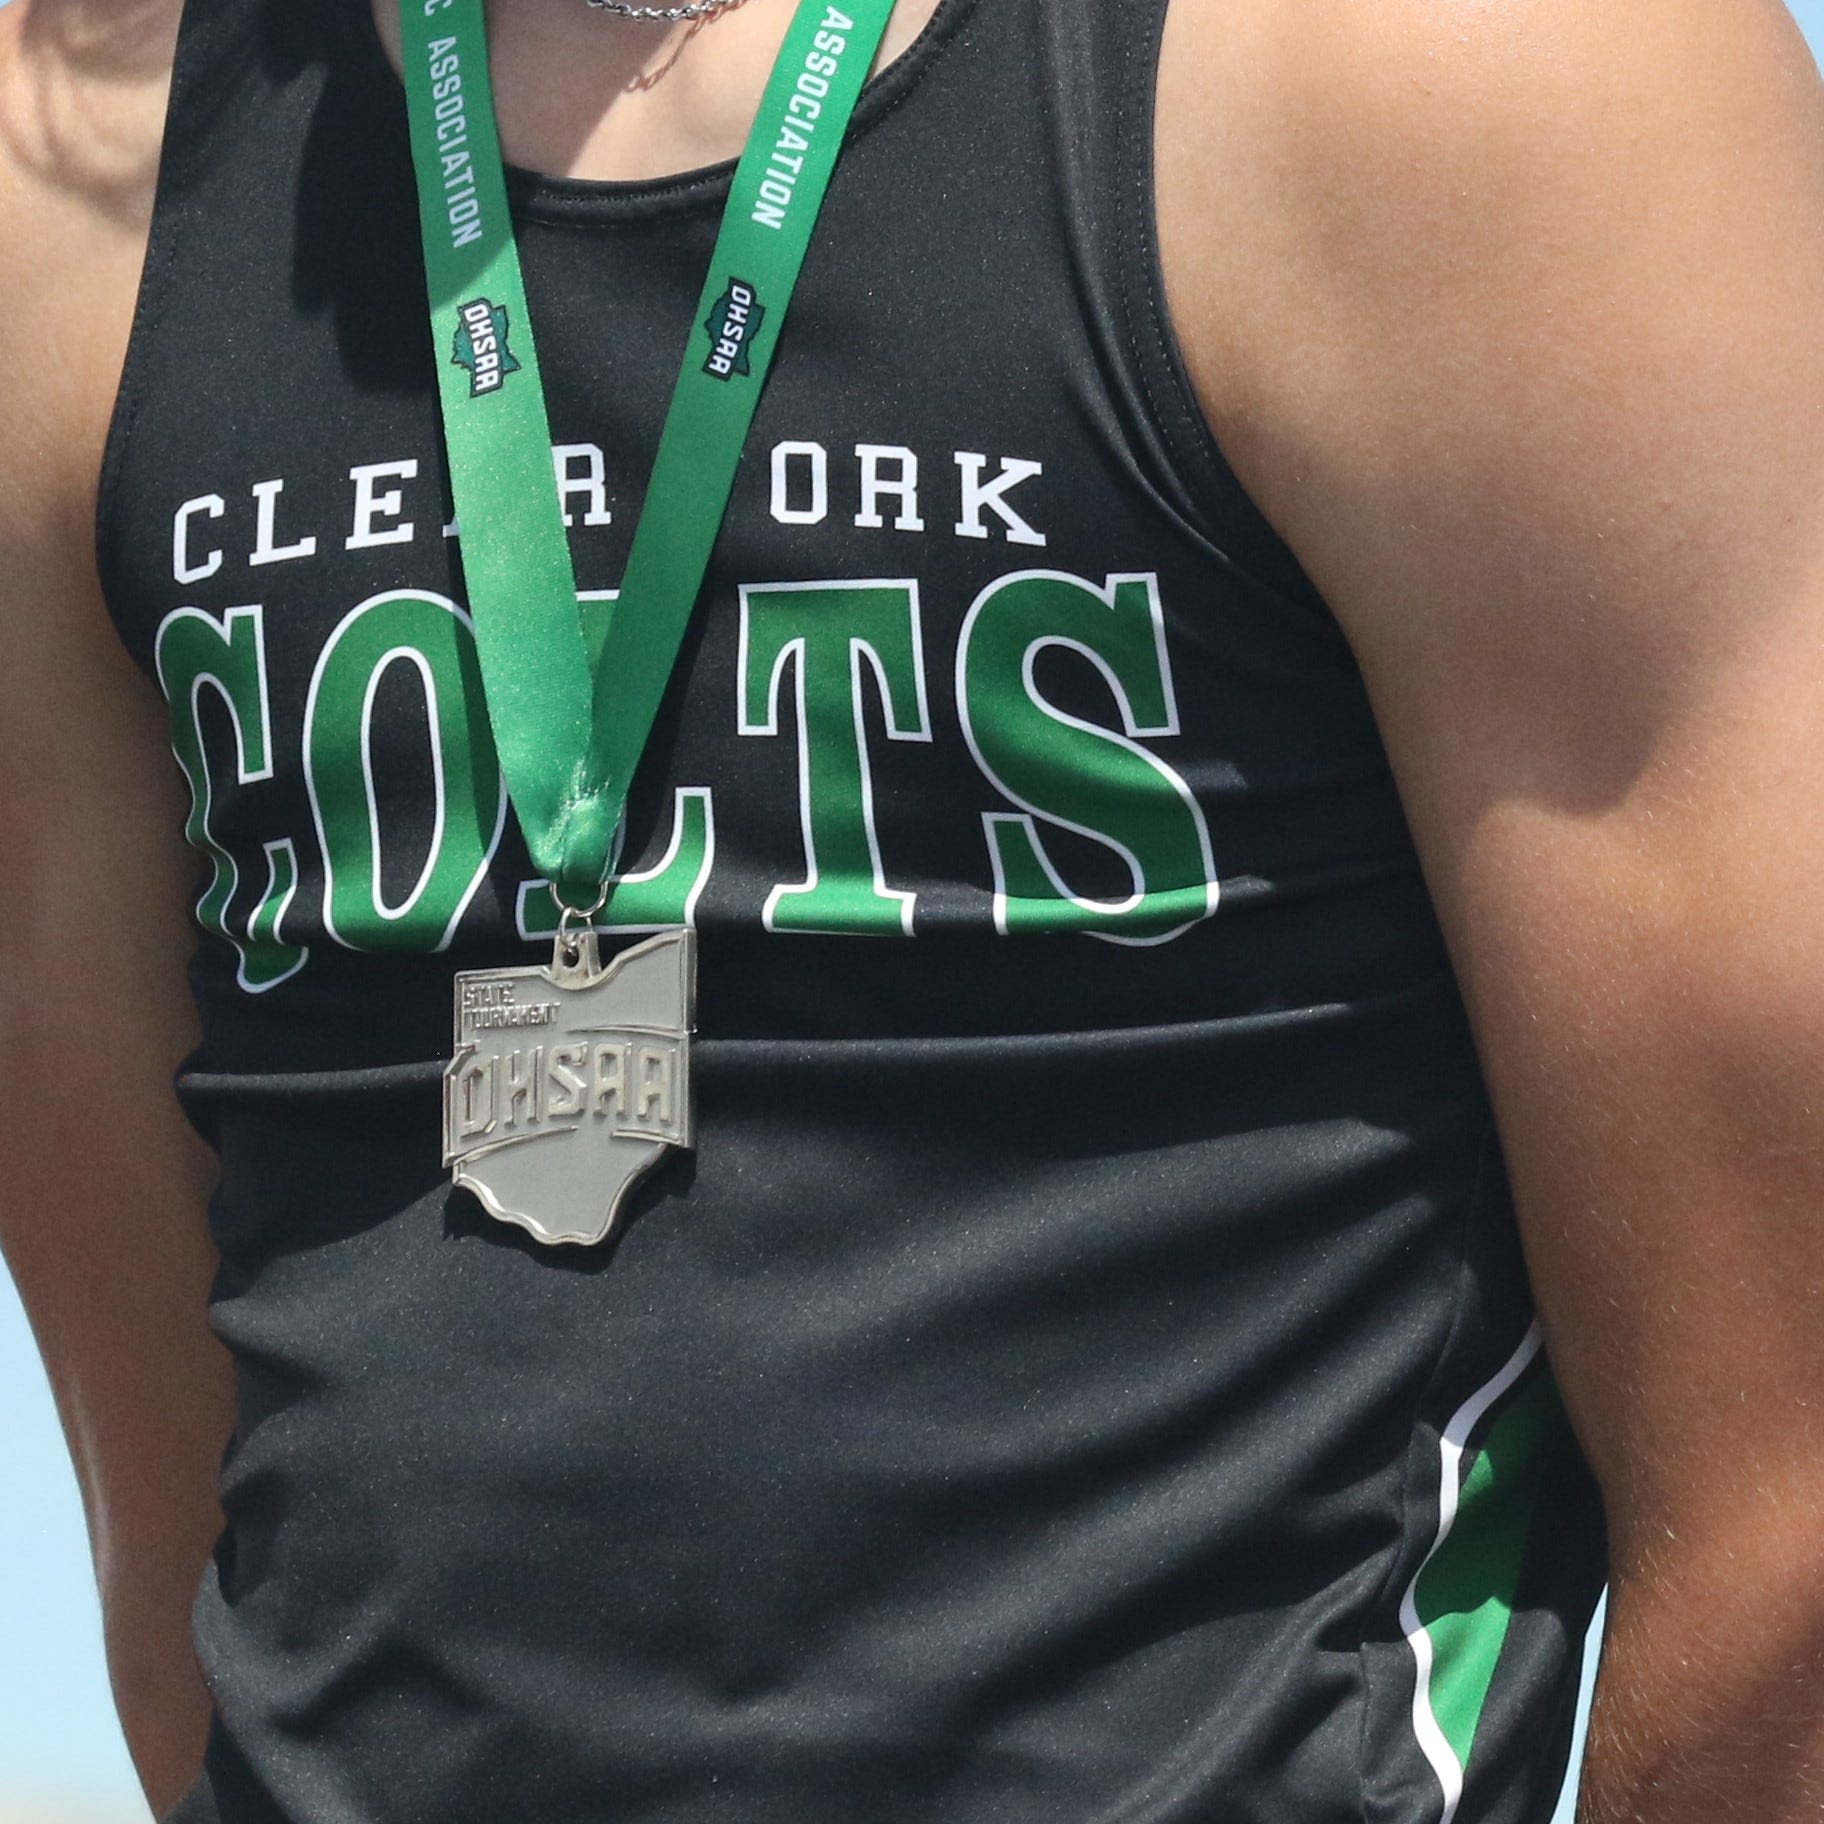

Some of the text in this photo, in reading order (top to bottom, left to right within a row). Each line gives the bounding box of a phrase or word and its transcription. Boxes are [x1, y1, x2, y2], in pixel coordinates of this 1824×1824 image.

[427, 36, 483, 248] ASSOCIATION
[750, 5, 855, 230] ASSOCIATION
[464, 303, 499, 391] OHSAA
[708, 285, 752, 374] OHSAA
[173, 439, 1048, 585] CLER ORK
[460, 1041, 677, 1138] OHSAA
